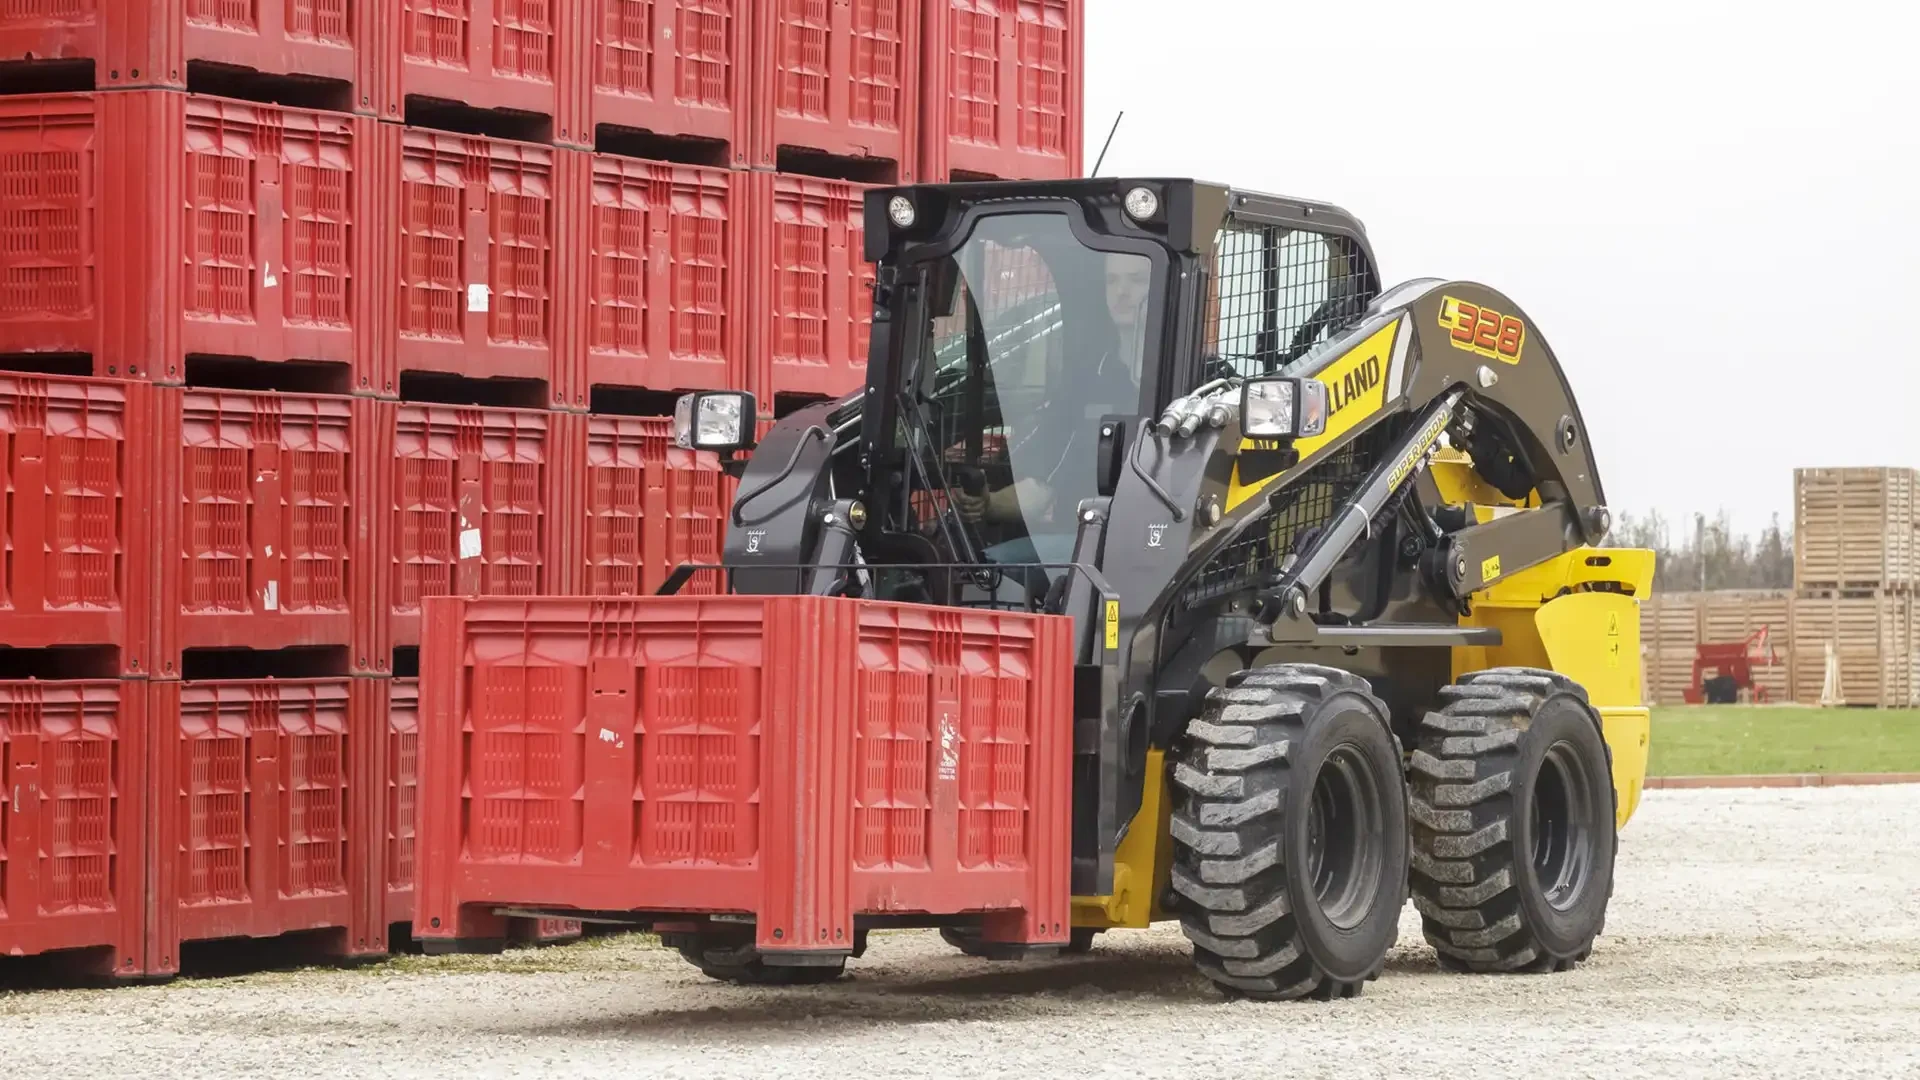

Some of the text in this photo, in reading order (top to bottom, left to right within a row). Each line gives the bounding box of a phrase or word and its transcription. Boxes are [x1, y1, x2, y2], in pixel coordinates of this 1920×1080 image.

[1439, 296, 1524, 363] L328
[1326, 354, 1380, 418] LLAND
[1388, 410, 1448, 491] SUPER BOOM
